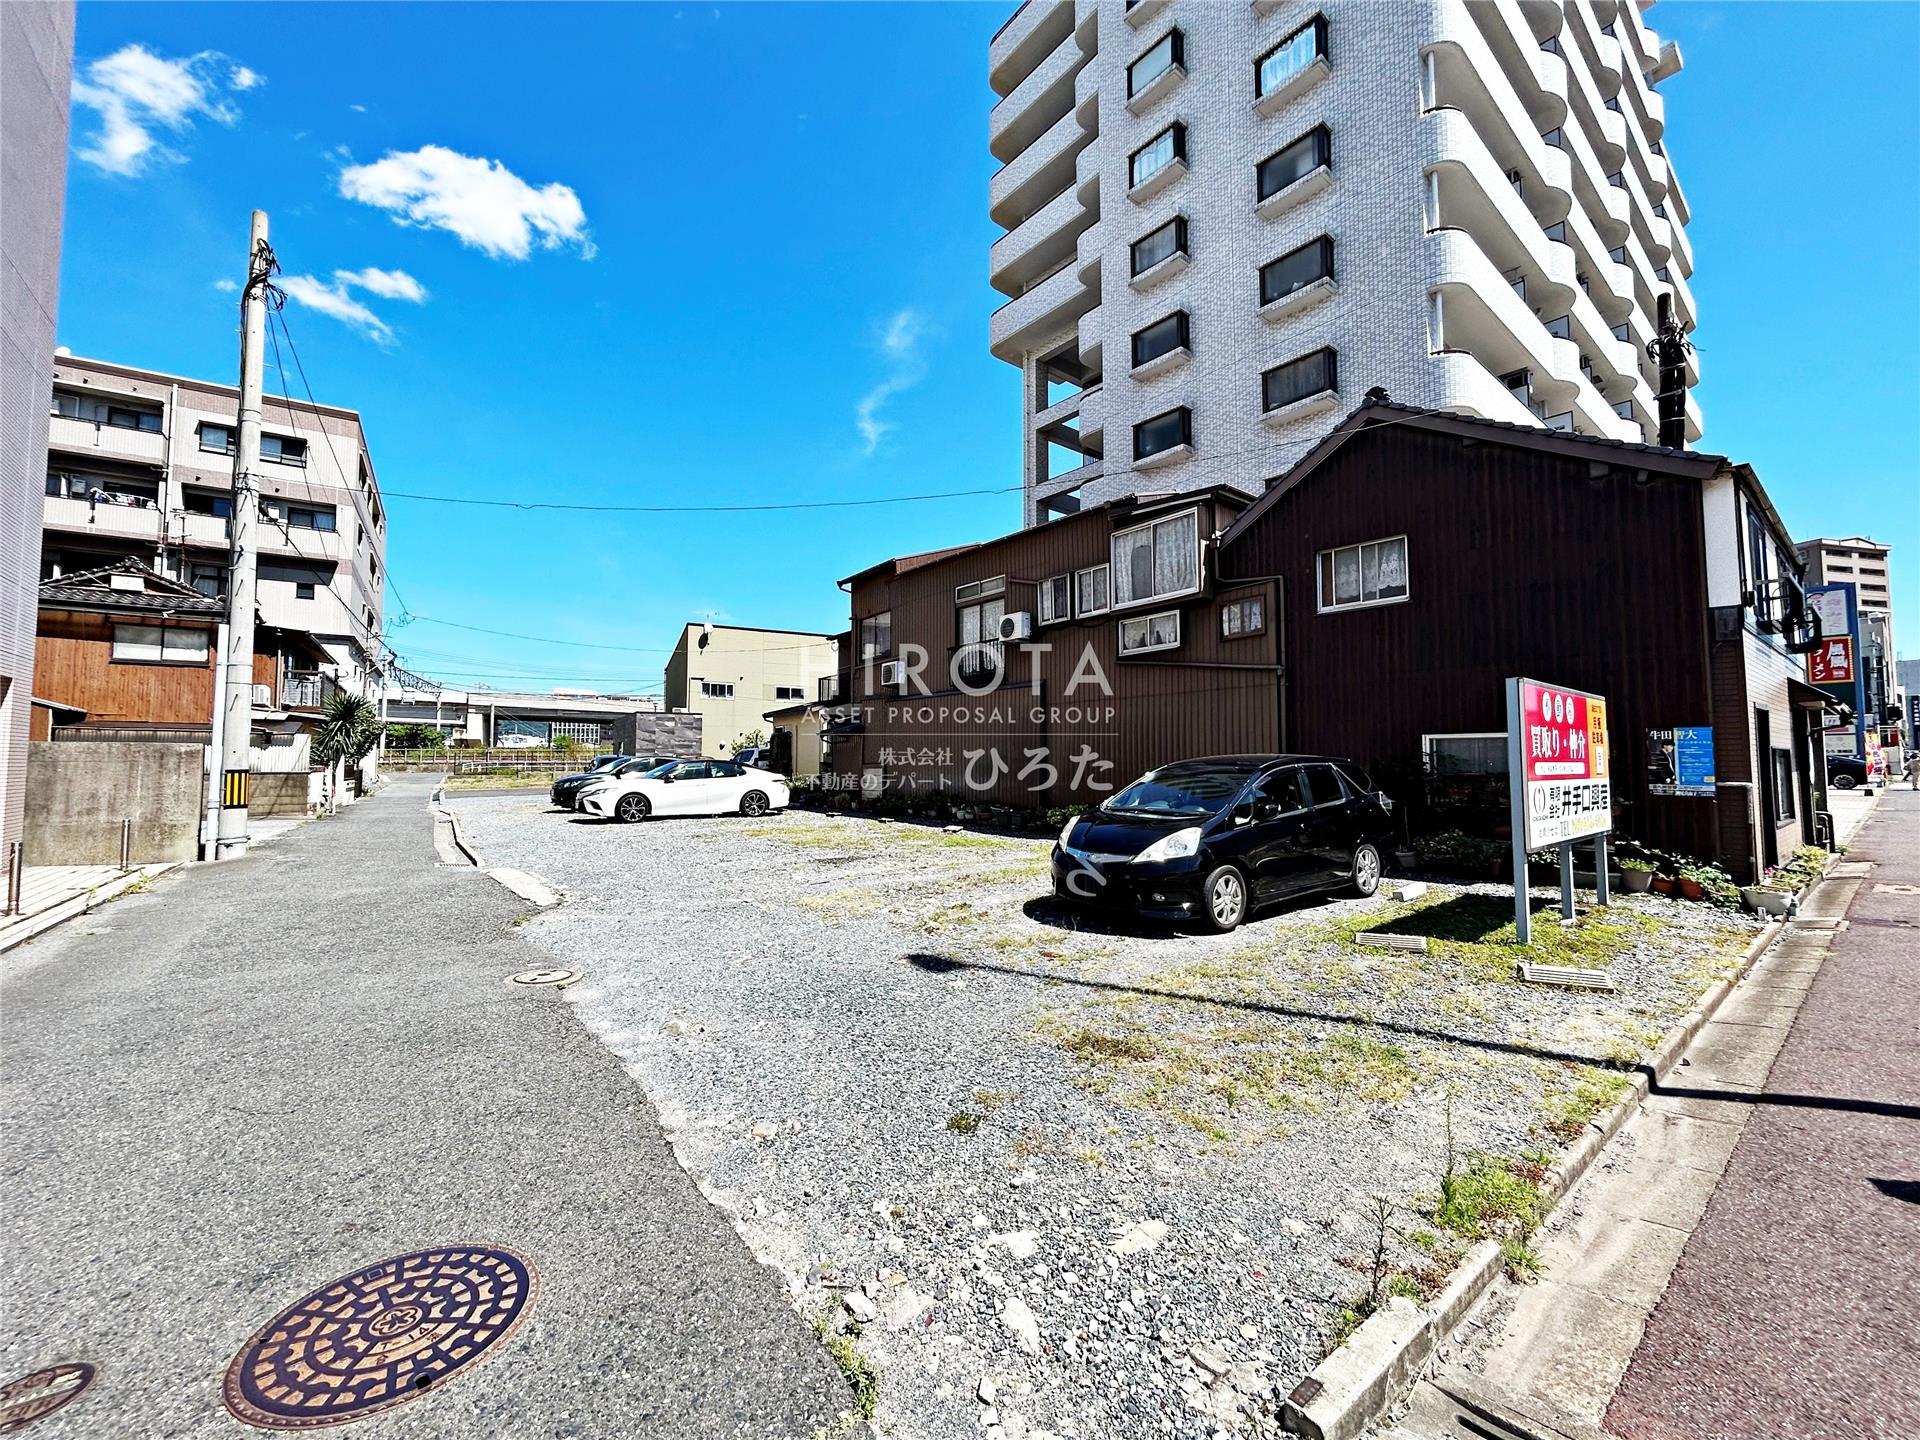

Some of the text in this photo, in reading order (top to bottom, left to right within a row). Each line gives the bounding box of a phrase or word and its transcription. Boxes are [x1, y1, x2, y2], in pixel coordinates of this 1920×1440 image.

[1530, 724, 1586, 759] 買取り・仲介
